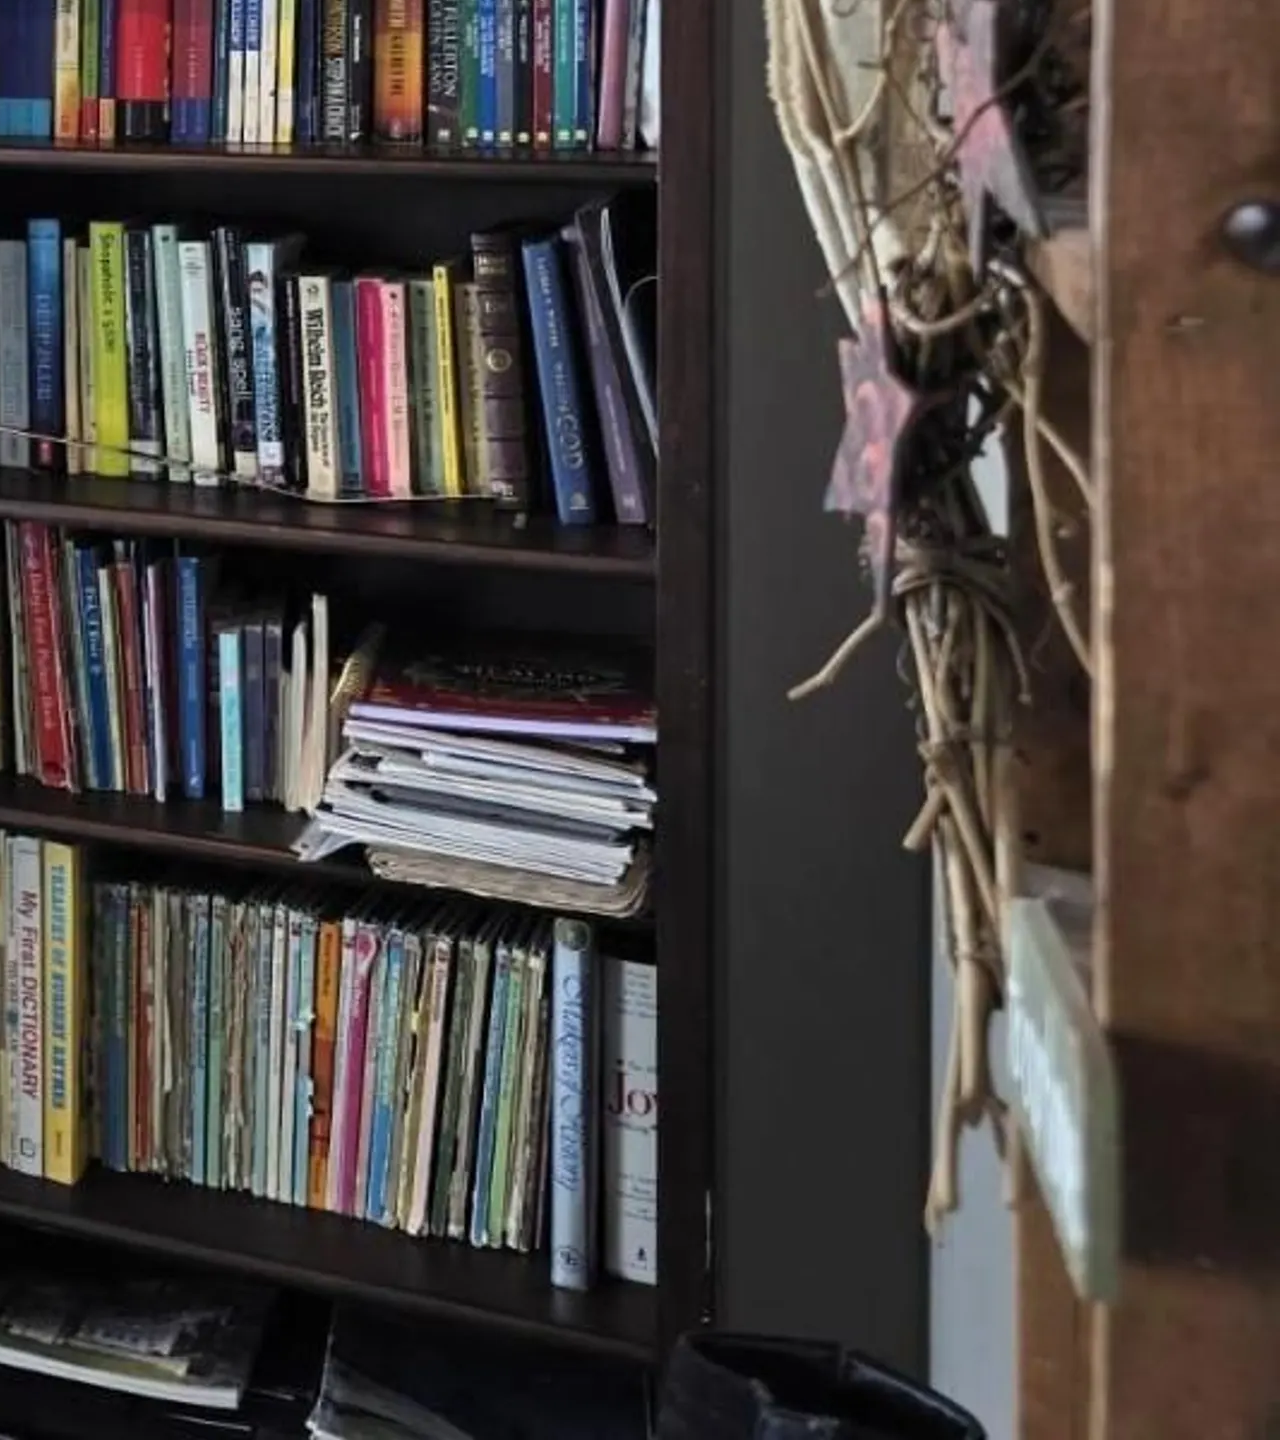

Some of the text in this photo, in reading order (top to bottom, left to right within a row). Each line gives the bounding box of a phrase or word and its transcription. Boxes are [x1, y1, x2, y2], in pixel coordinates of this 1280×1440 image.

[430, 52, 443, 93] LAND
[441, 6, 459, 97] FULLERTON
[196, 333, 211, 414] BLACK BEAUTY
[228, 307, 254, 400] sang spell
[305, 307, 328, 408] Wilhelm Reich
[557, 413, 585, 469] GOD
[50, 863, 66, 944] TREASURY
[17, 890, 40, 1100] My First DICTIONARY
[49, 971, 66, 1040] NURSERY
[49, 1045, 66, 1111] RHYMES
